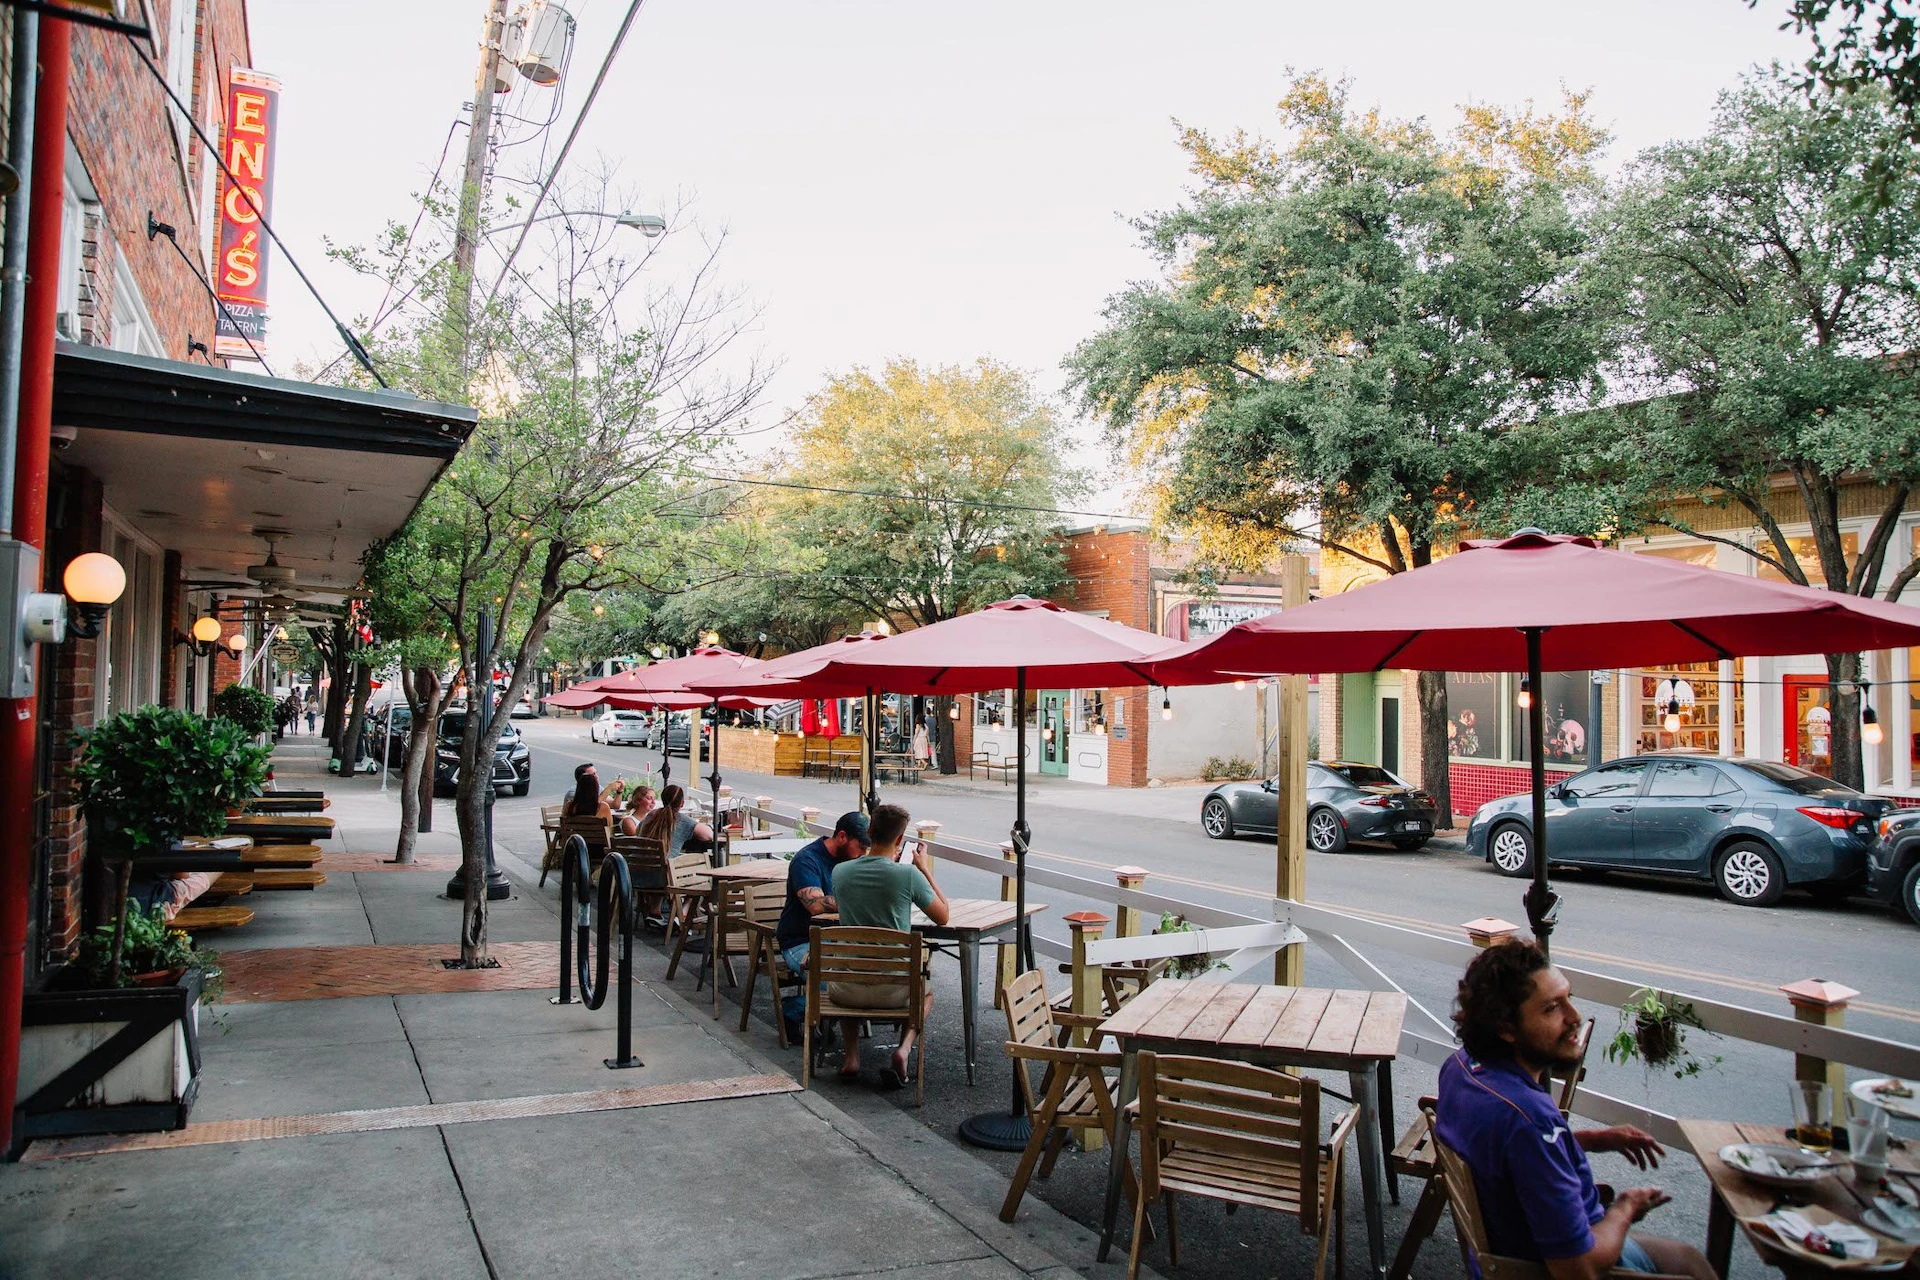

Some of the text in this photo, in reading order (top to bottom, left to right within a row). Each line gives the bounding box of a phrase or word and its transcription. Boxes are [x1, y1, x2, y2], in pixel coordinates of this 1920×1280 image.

[224, 91, 266, 288] ENO'S
[225, 303, 254, 318] PIZZA
[219, 318, 258, 334] TAVERN
